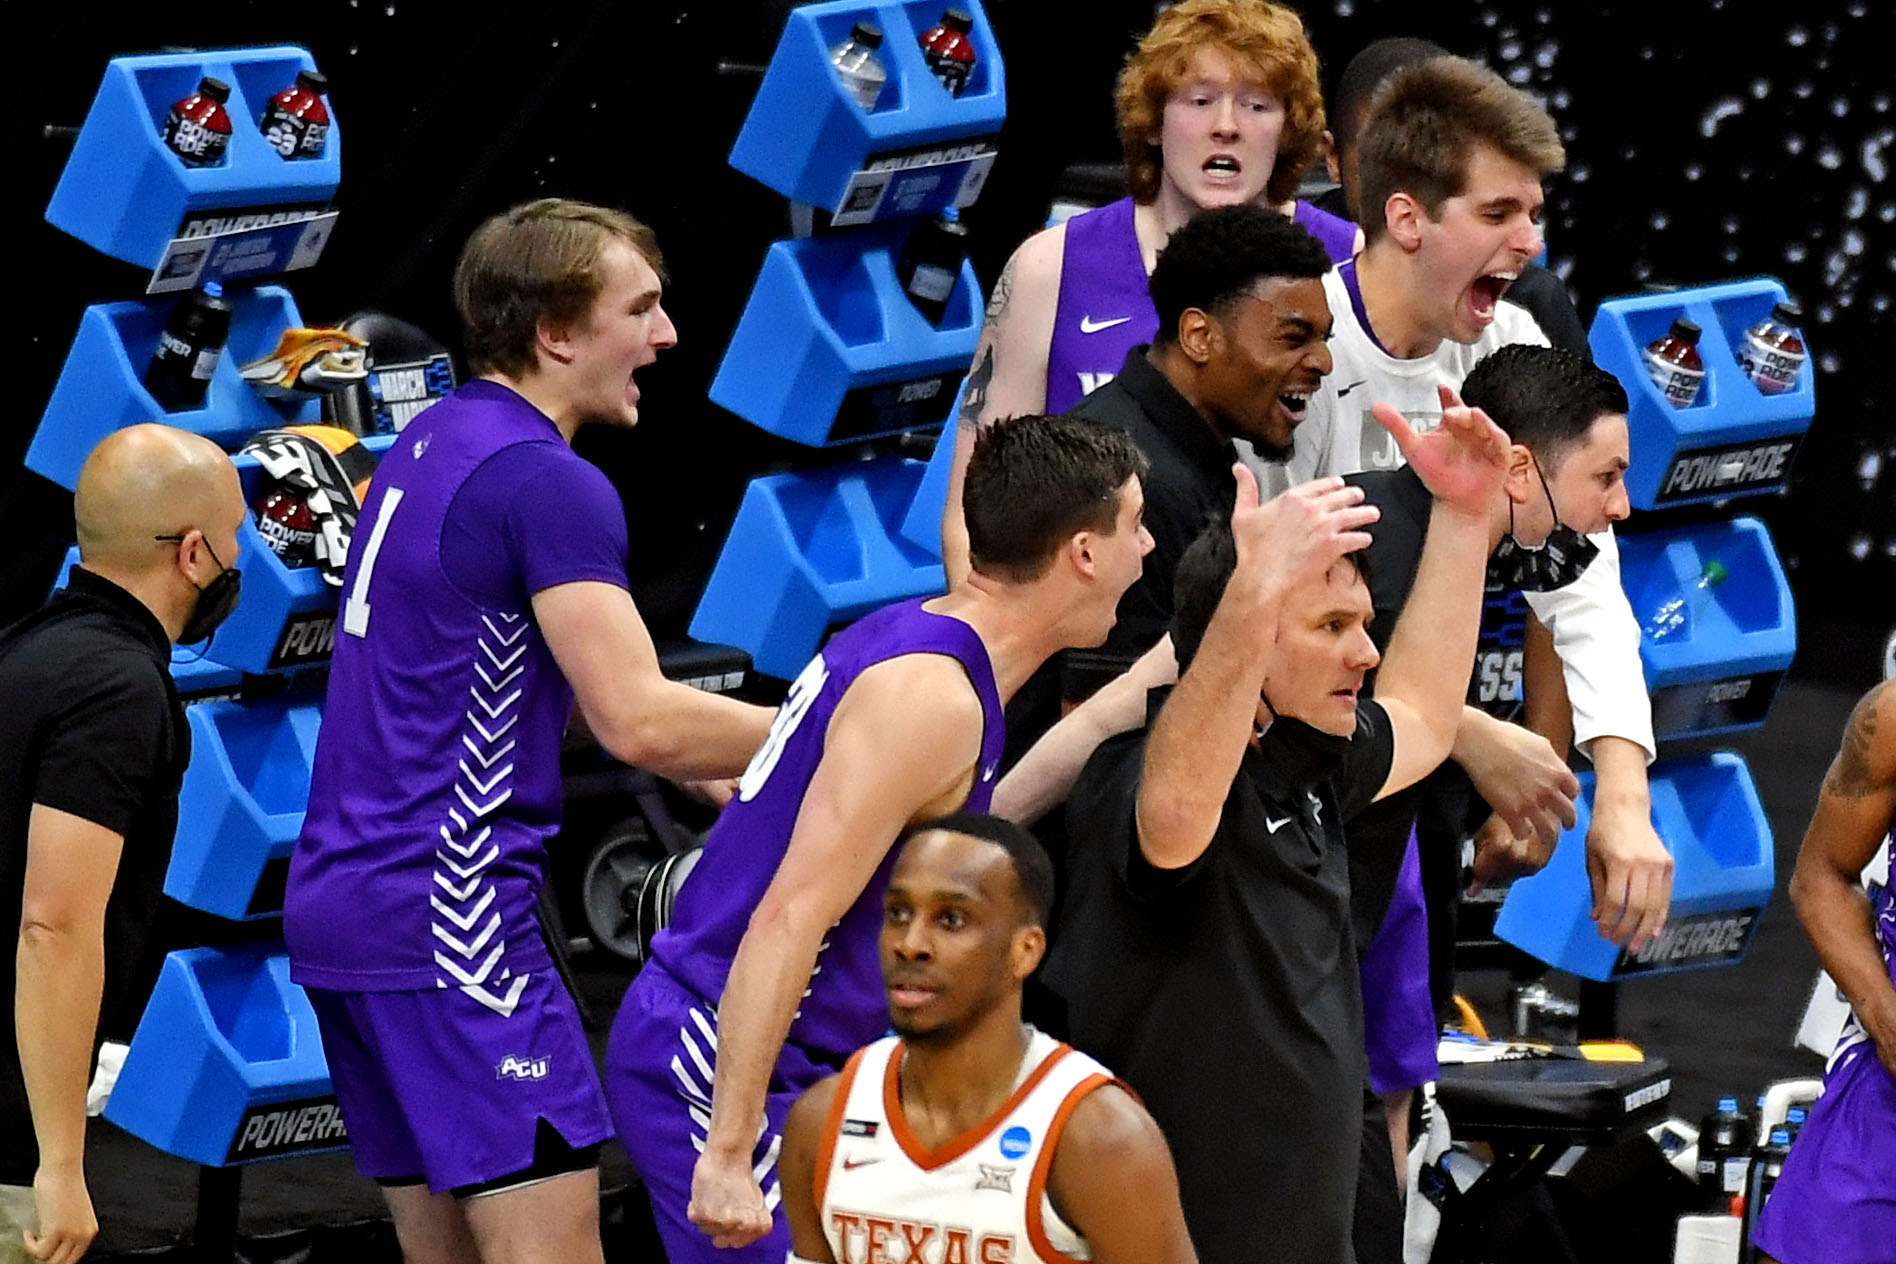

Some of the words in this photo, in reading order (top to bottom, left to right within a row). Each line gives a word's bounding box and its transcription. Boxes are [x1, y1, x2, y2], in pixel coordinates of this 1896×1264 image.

[343, 482, 404, 638] 1
[1621, 916, 1752, 967] OWERADE
[500, 1055, 548, 1079] ACU
[238, 1104, 348, 1152] POWERA
